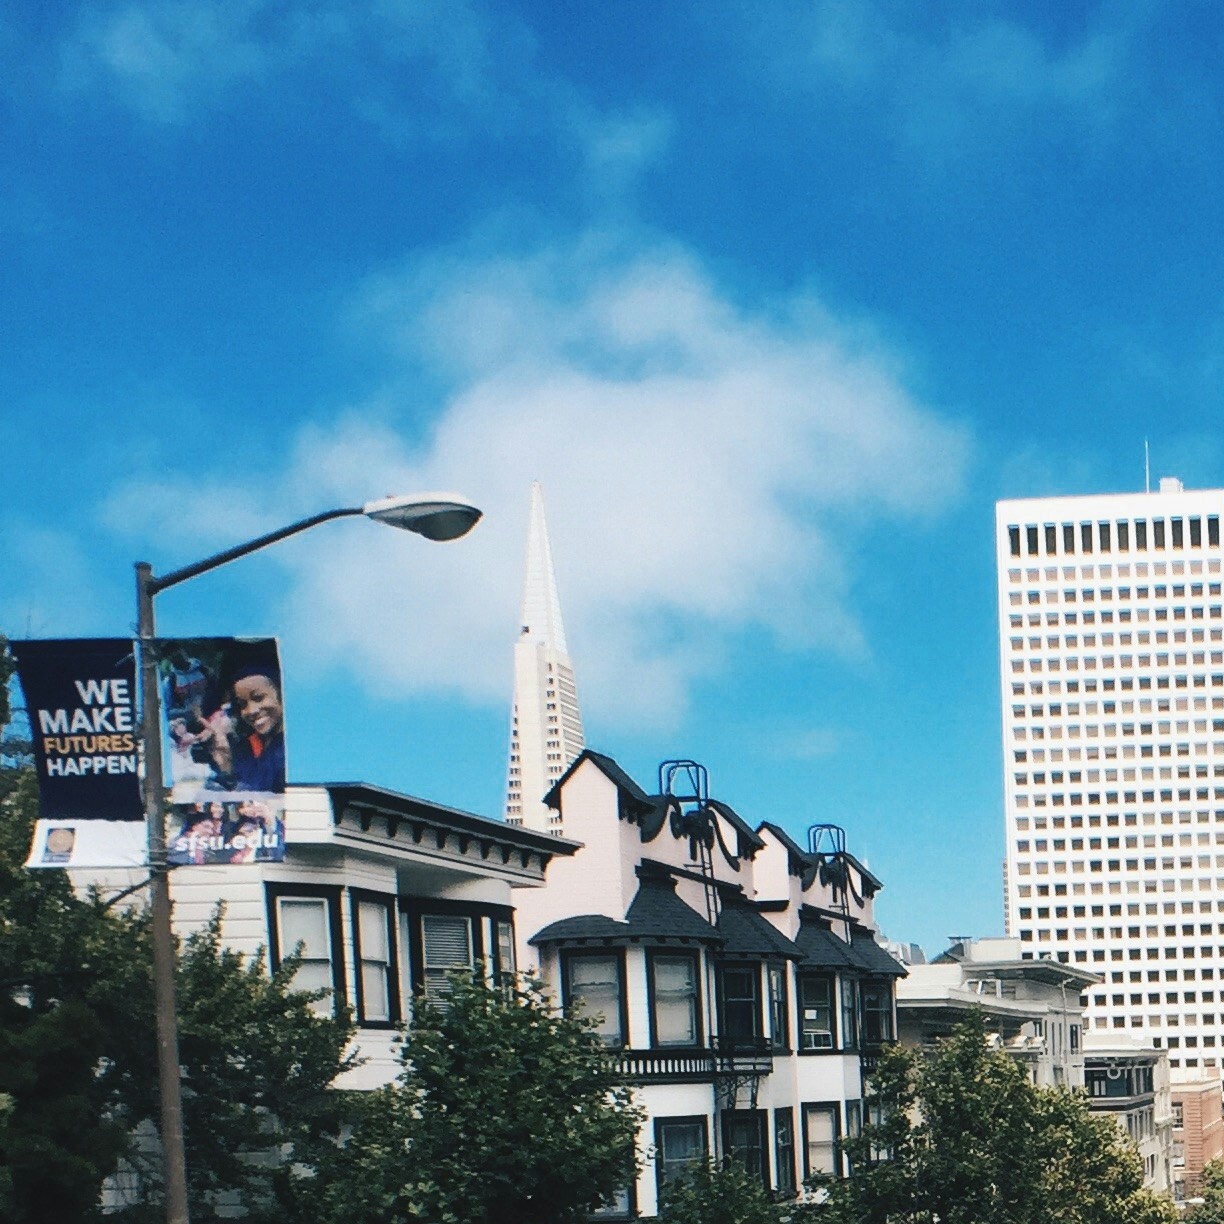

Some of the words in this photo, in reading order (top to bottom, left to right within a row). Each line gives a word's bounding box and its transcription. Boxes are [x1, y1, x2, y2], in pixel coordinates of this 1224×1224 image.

[74, 679, 130, 705] WE
[38, 707, 133, 733] MAKE
[44, 733, 135, 754] FUTURES
[47, 755, 136, 776] HAPPEN
[175, 828, 278, 851] sfsu.edu
